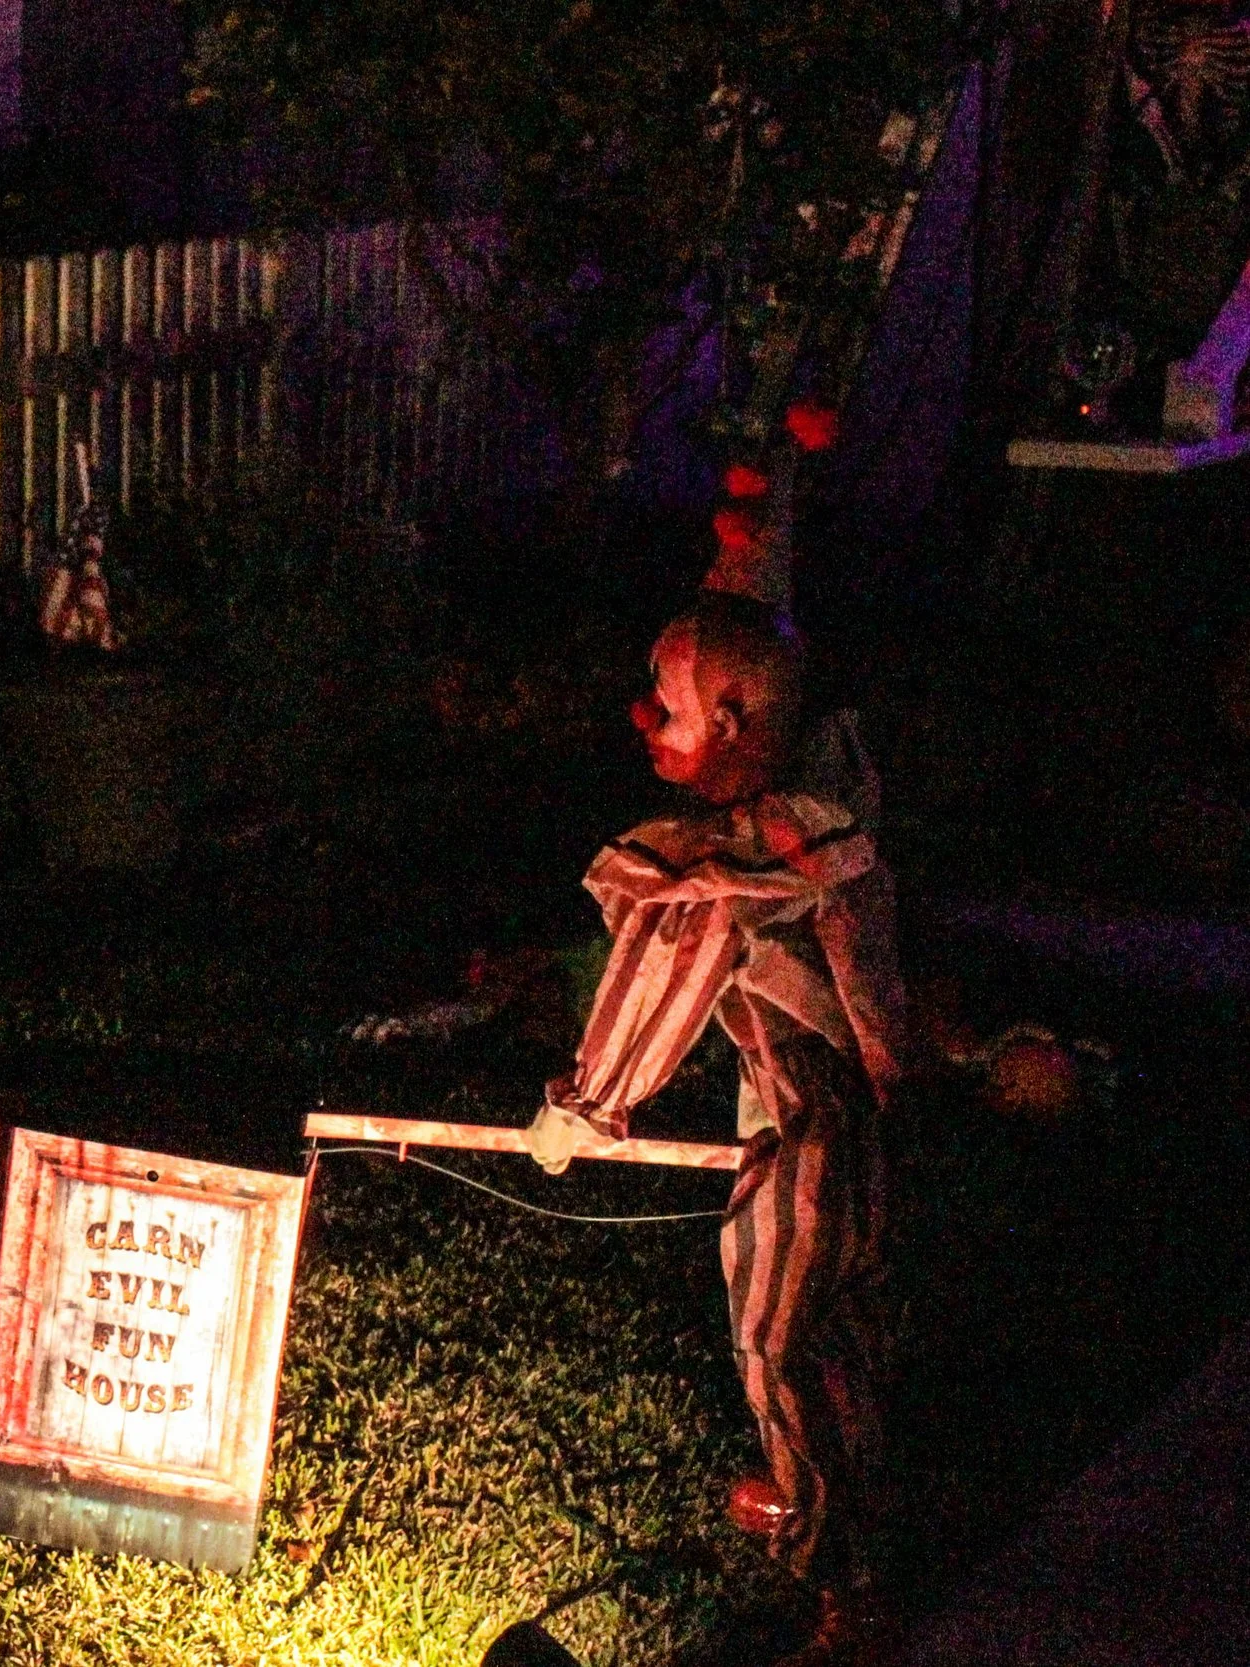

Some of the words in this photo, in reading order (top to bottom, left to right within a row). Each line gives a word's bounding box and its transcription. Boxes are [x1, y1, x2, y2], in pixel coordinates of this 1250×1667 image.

[86, 1220, 205, 1268] CARN
[87, 1270, 190, 1316] EVIL
[91, 1322, 176, 1363] FUN
[64, 1359, 194, 1413] HOUSE
